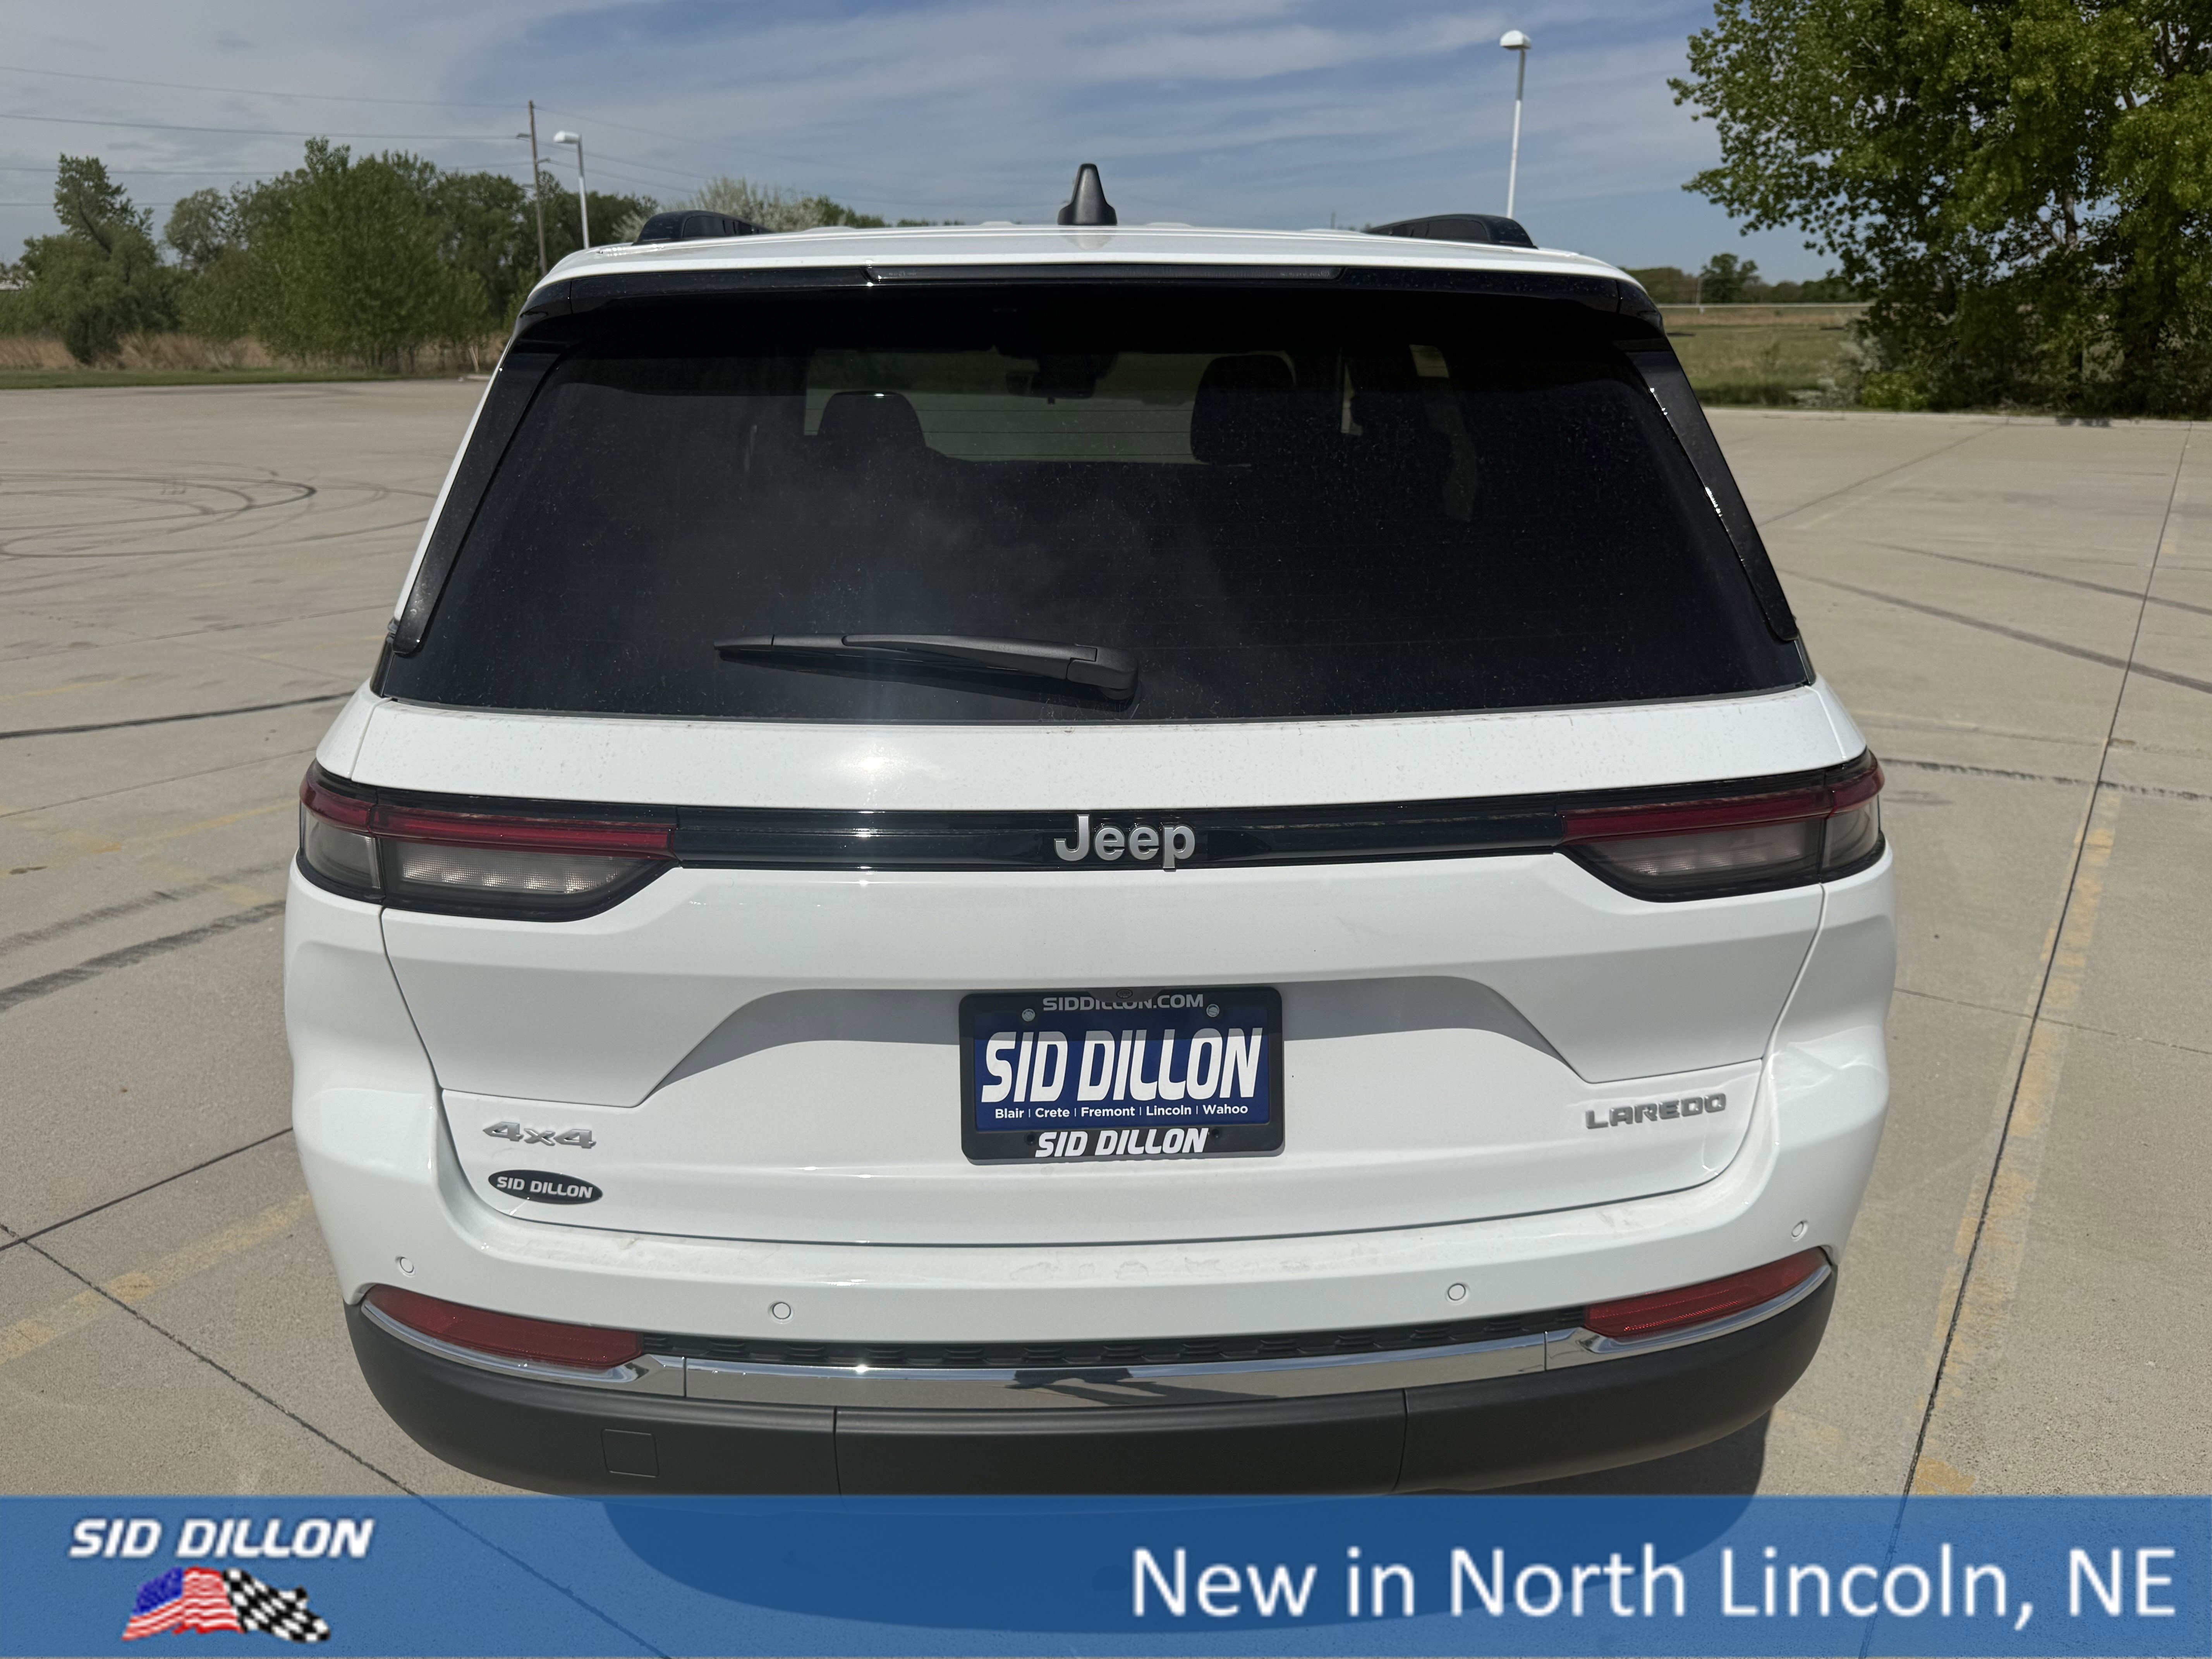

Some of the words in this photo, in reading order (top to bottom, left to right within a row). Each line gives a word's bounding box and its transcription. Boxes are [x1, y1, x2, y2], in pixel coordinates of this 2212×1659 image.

[1054, 814, 1195, 872] Jeep
[981, 1031, 1068, 1103] SID
[1077, 1027, 1263, 1101] DILLON
[995, 1108, 1024, 1119] Blair
[1035, 1108, 1070, 1118] Crete
[1081, 1106, 1135, 1117] Fremont
[1146, 1105, 1192, 1116] Lincoln
[1202, 1104, 1248, 1115] Wahoo
[1585, 1093, 1726, 1129] LAREDO
[483, 1121, 597, 1149] 4x4
[1035, 1131, 1088, 1158] SID
[1094, 1128, 1209, 1155] DILLON
[497, 1176, 525, 1191] SID
[530, 1180, 593, 1199] DILLON
